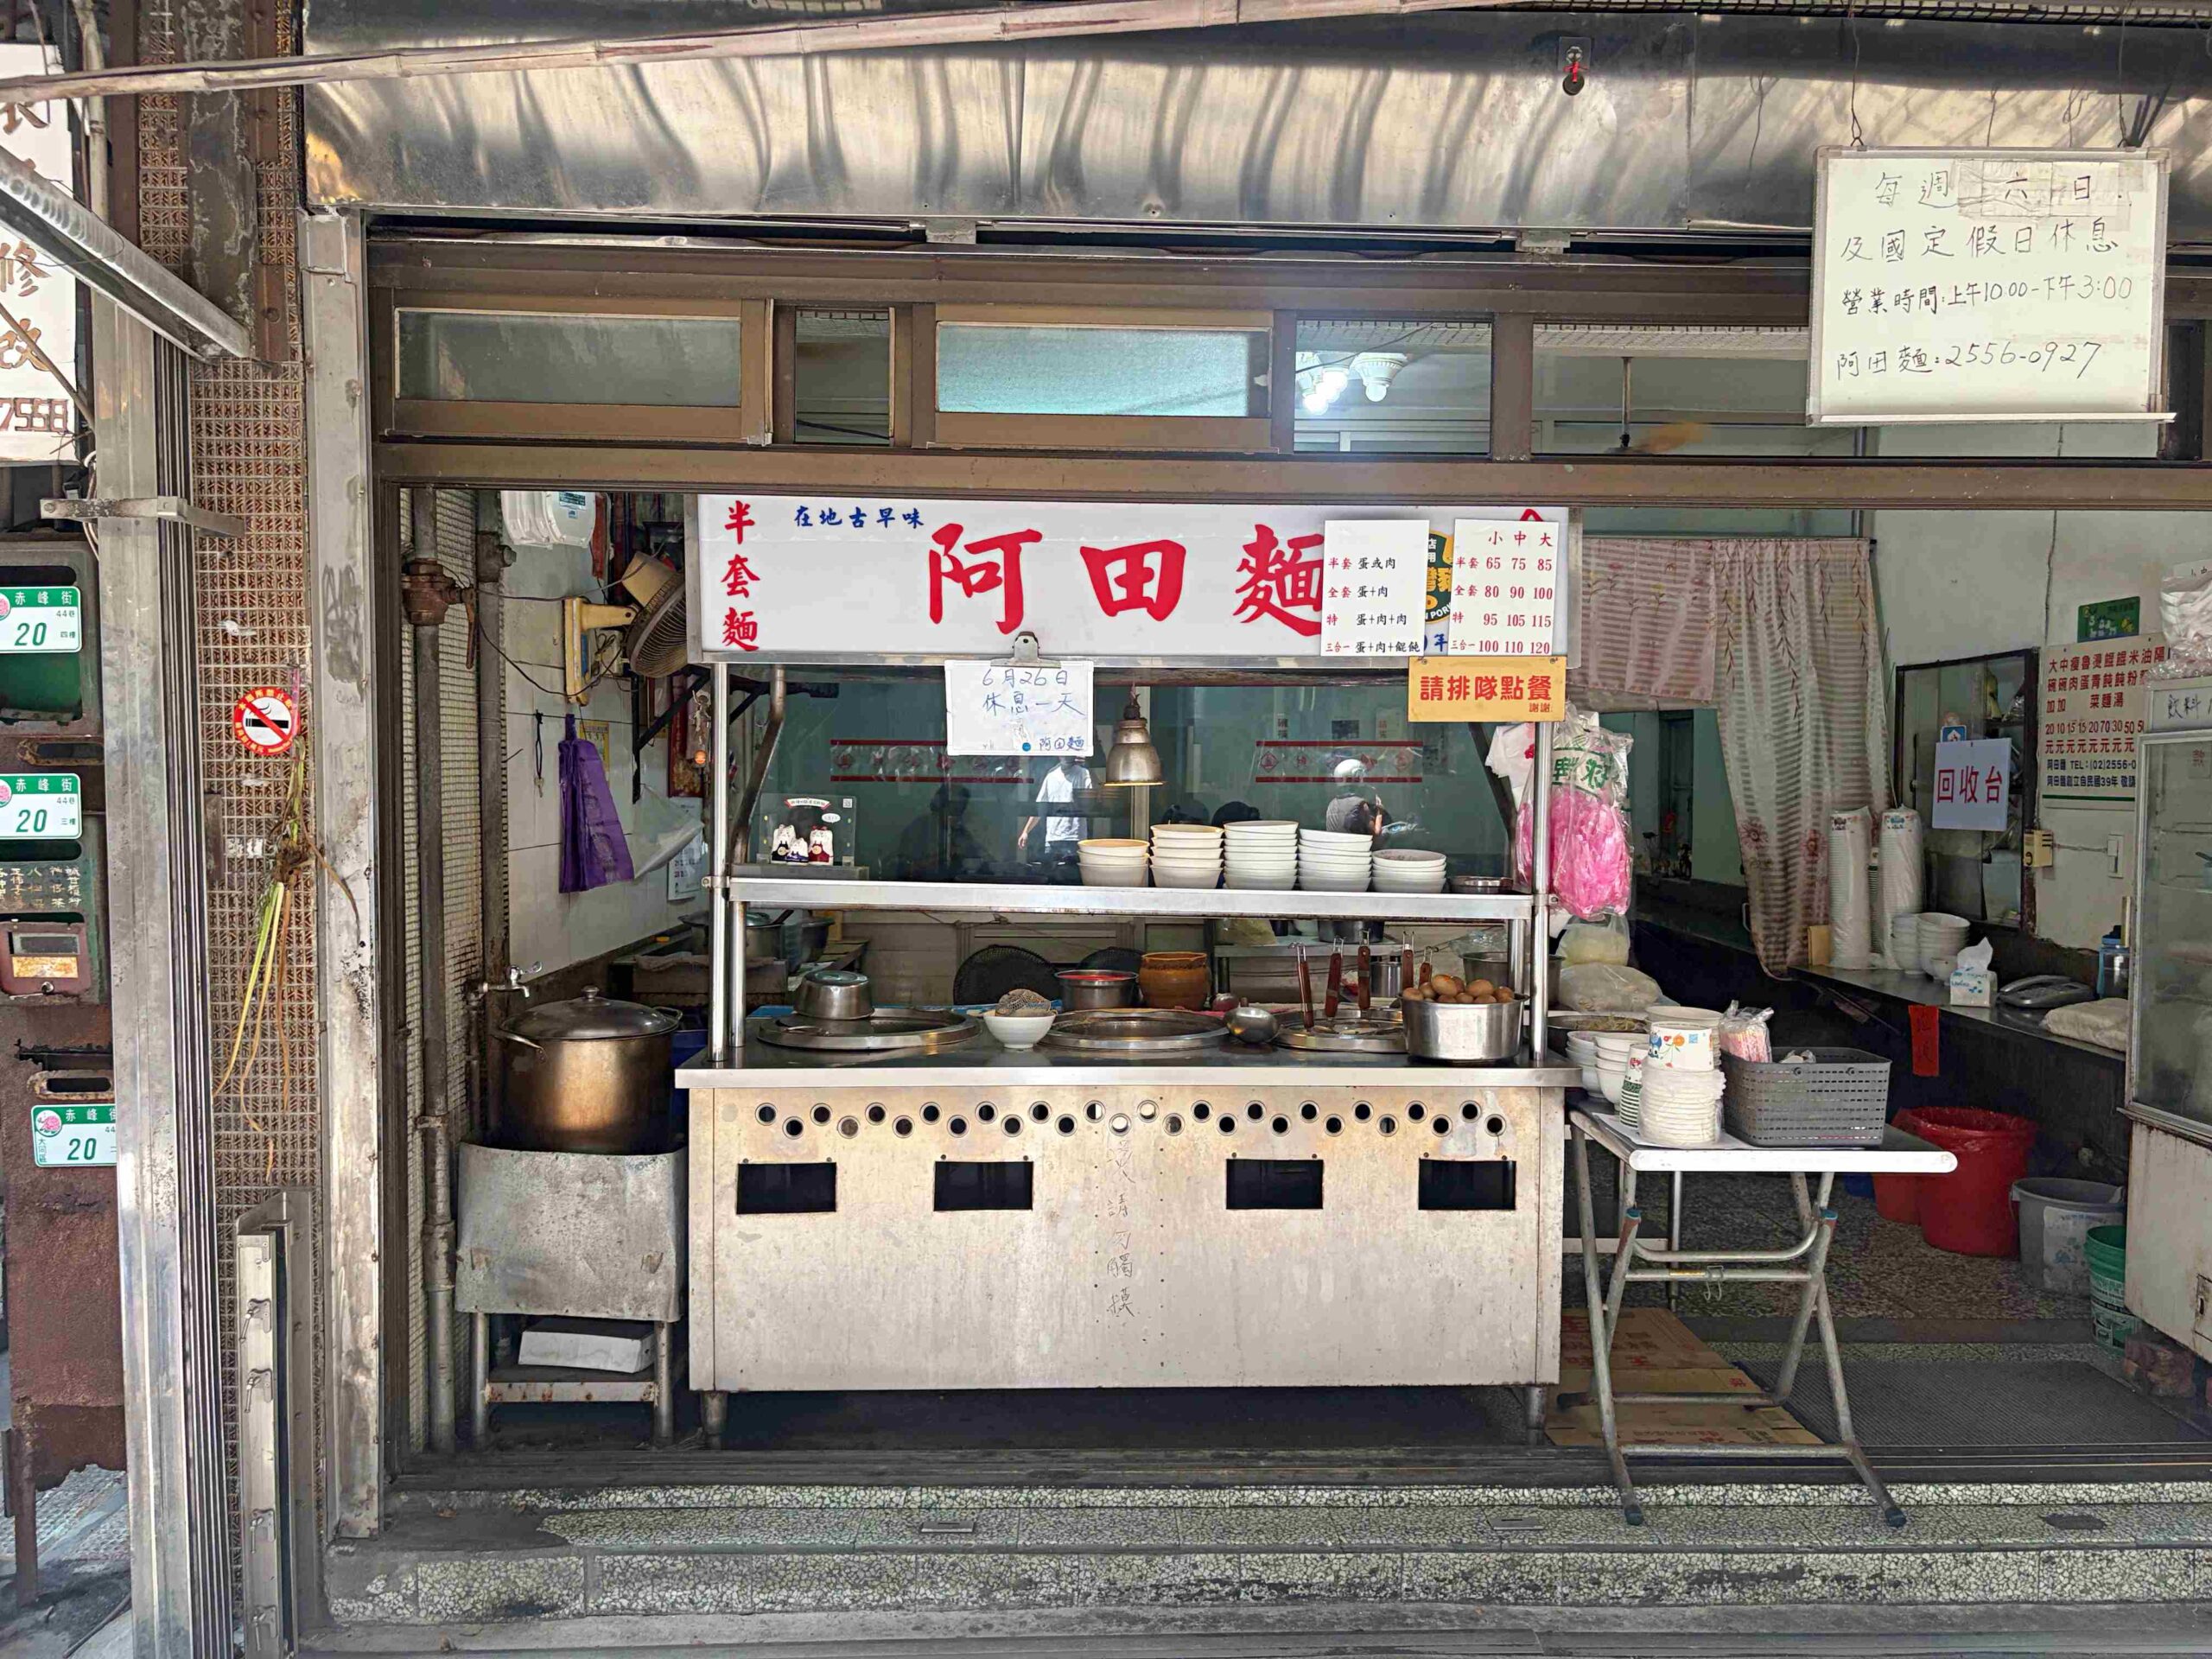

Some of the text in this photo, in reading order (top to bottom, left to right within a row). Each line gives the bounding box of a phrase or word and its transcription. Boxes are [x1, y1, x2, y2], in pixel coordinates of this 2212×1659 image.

[1840, 217, 2119, 263] 及國定假日休息
[794, 505, 925, 529] 在地古早味
[1488, 531, 1553, 547] 小 中 大
[1328, 557, 1395, 569] 半套 蛋或肉
[1456, 556, 1552, 571] 半套 65 75 85
[720, 500, 760, 652] 半套麵
[929, 523, 1325, 637] 阿田麵
[15, 591, 73, 605] 赤峰街
[1327, 585, 1388, 598] 全套 蛋+肉
[1454, 585, 1553, 600] 全套 80 90 100
[1326, 613, 1407, 626] 特 蛋+肉+肉
[1452, 612, 1551, 627] 特 95 105 115
[14, 622, 47, 646] 20
[1325, 641, 1350, 652] 三合一
[1450, 639, 1550, 654] 三合一 100 110 120
[982, 668, 1068, 688] 6月26日
[1421, 676, 1552, 701] 請排隊點餐
[982, 691, 1086, 717] 休息一天
[16, 779, 73, 791] 赤峰街
[1937, 766, 2003, 804] 回收台
[16, 809, 48, 832] 20
[67, 1138, 97, 1160] 20
